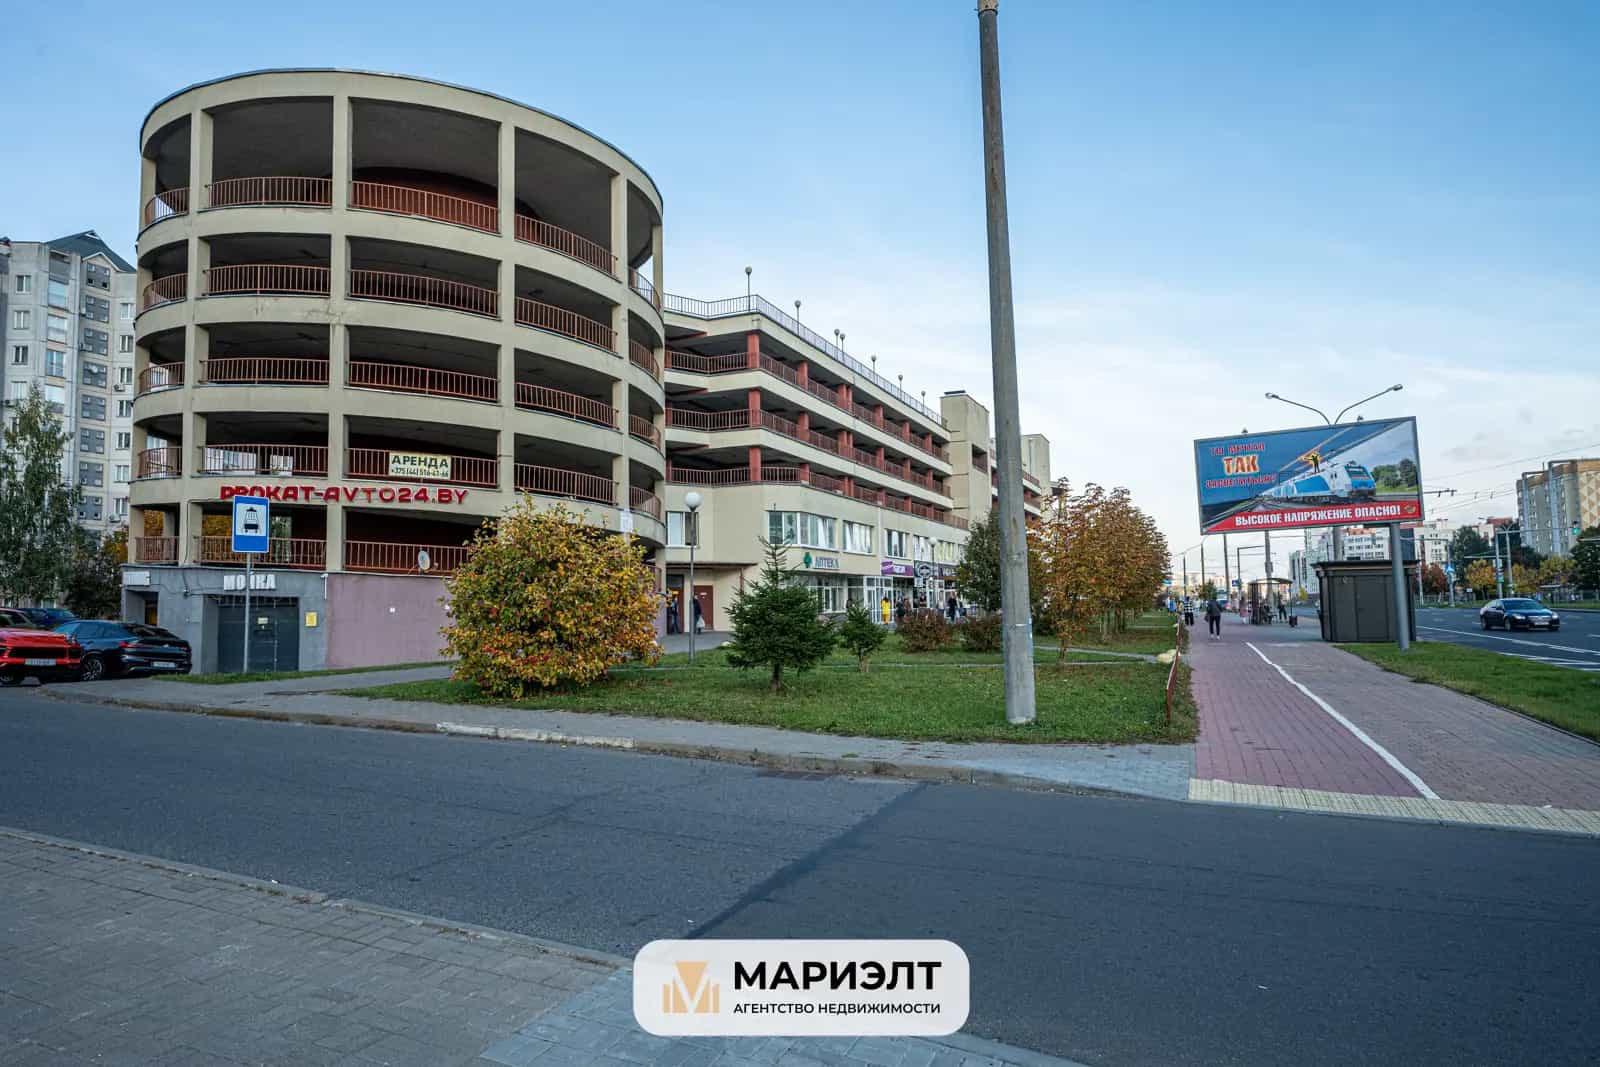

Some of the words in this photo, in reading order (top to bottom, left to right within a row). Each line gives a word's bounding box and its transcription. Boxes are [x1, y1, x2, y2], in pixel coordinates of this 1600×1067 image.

[391, 455, 448, 469] АРЕНДА
[1223, 455, 1260, 476] ТАК
[219, 485, 468, 504] PROKAT-AVTO24.BY
[1235, 513, 1282, 526] ВЫСОКОЕ
[1284, 508, 1353, 523] НАПРЯЖЕНИЕ
[1355, 505, 1401, 518] ОПАСНО!
